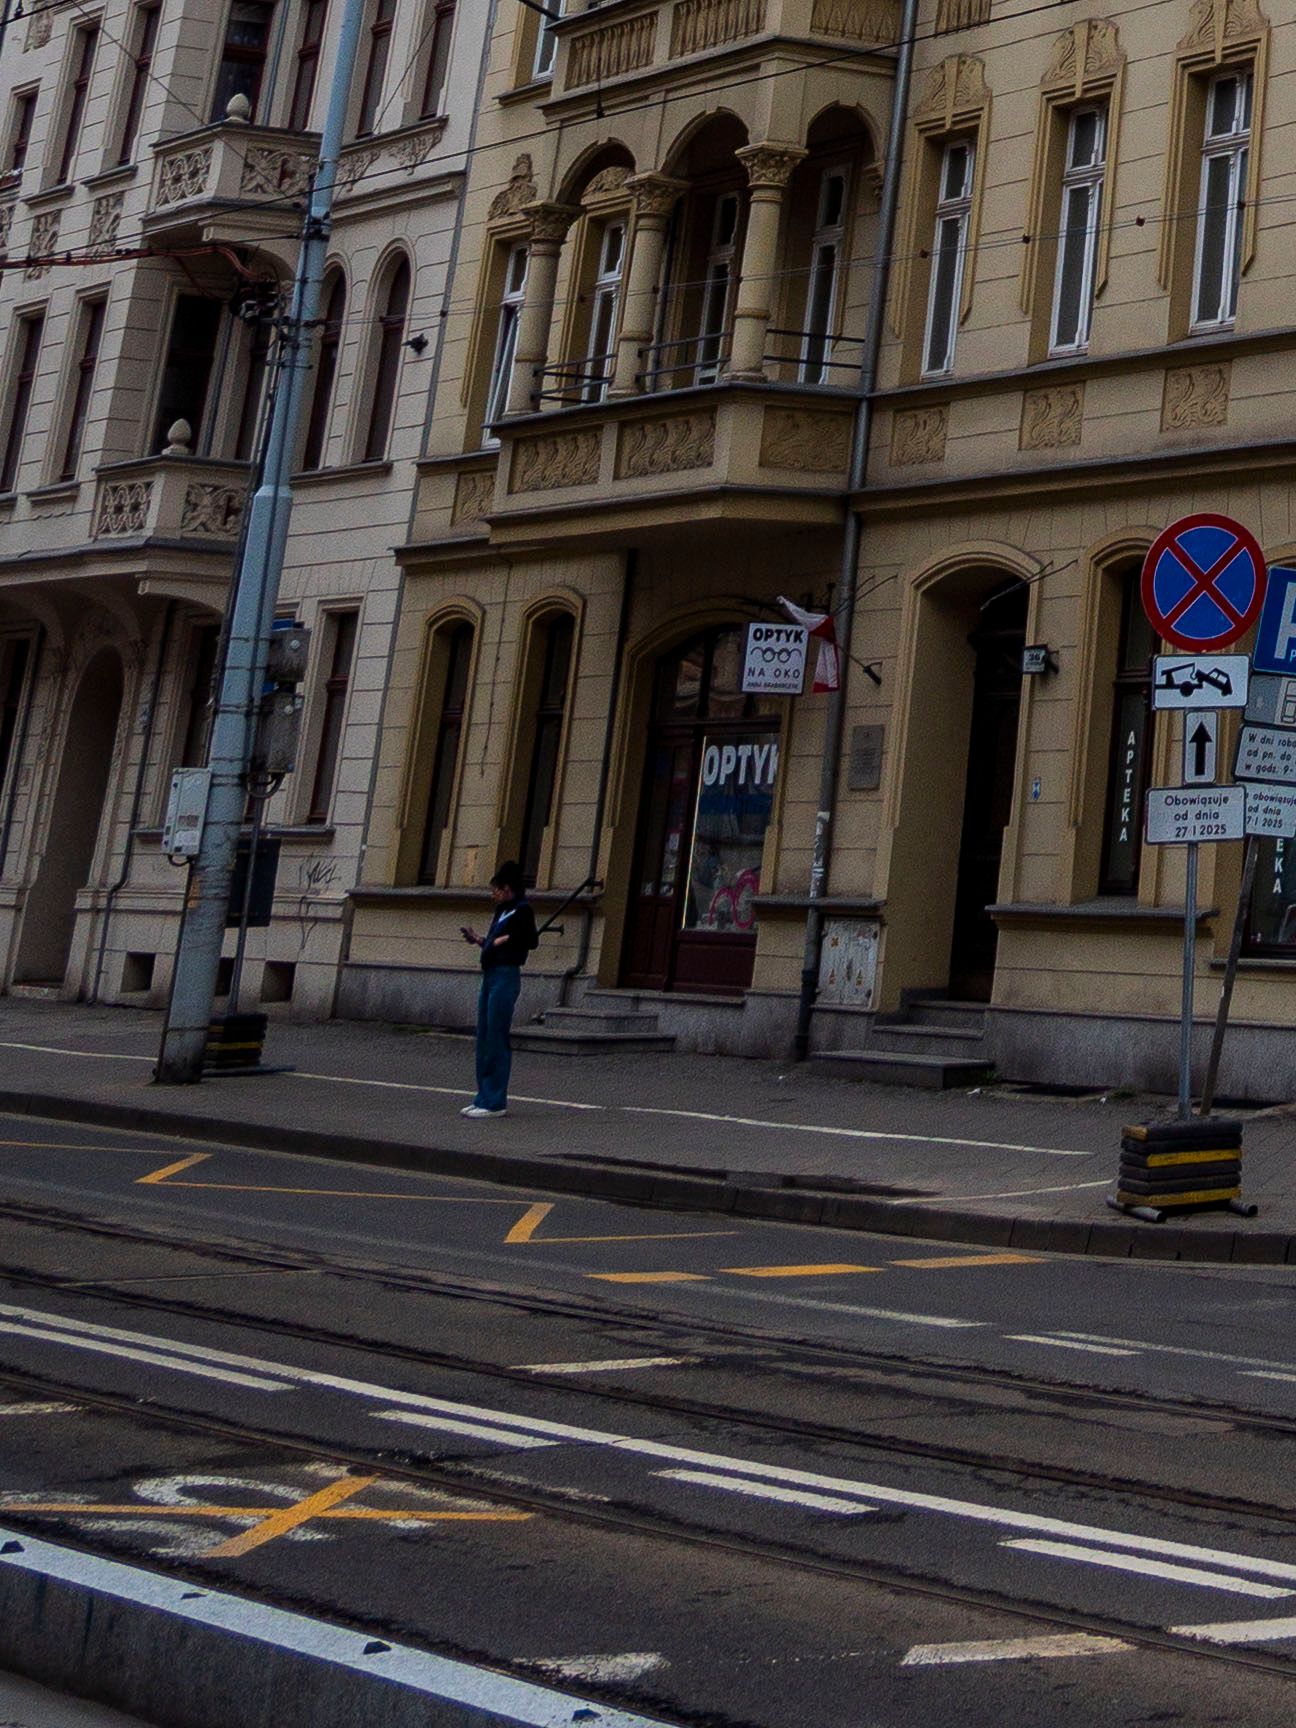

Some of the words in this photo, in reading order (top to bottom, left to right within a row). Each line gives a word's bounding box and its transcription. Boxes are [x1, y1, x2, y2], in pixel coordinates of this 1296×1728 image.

[752, 627, 804, 643] OPTYK
[747, 666, 765, 678] NA
[774, 668, 800, 679] OKO
[1248, 733, 1257, 743] W
[1260, 735, 1275, 746] dni
[1246, 747, 1259, 757] od
[1262, 751, 1277, 761] pn.
[1280, 751, 1292, 761] do
[1120, 730, 1135, 842] APTEKA
[1164, 794, 1230, 806] Obowiązuje
[1174, 811, 1188, 821] od
[1195, 809, 1220, 820] dnia
[1247, 804, 1259, 813] od
[1263, 805, 1281, 815] dnia
[1175, 825, 1188, 838] 27
[1200, 824, 1227, 835] 2025
